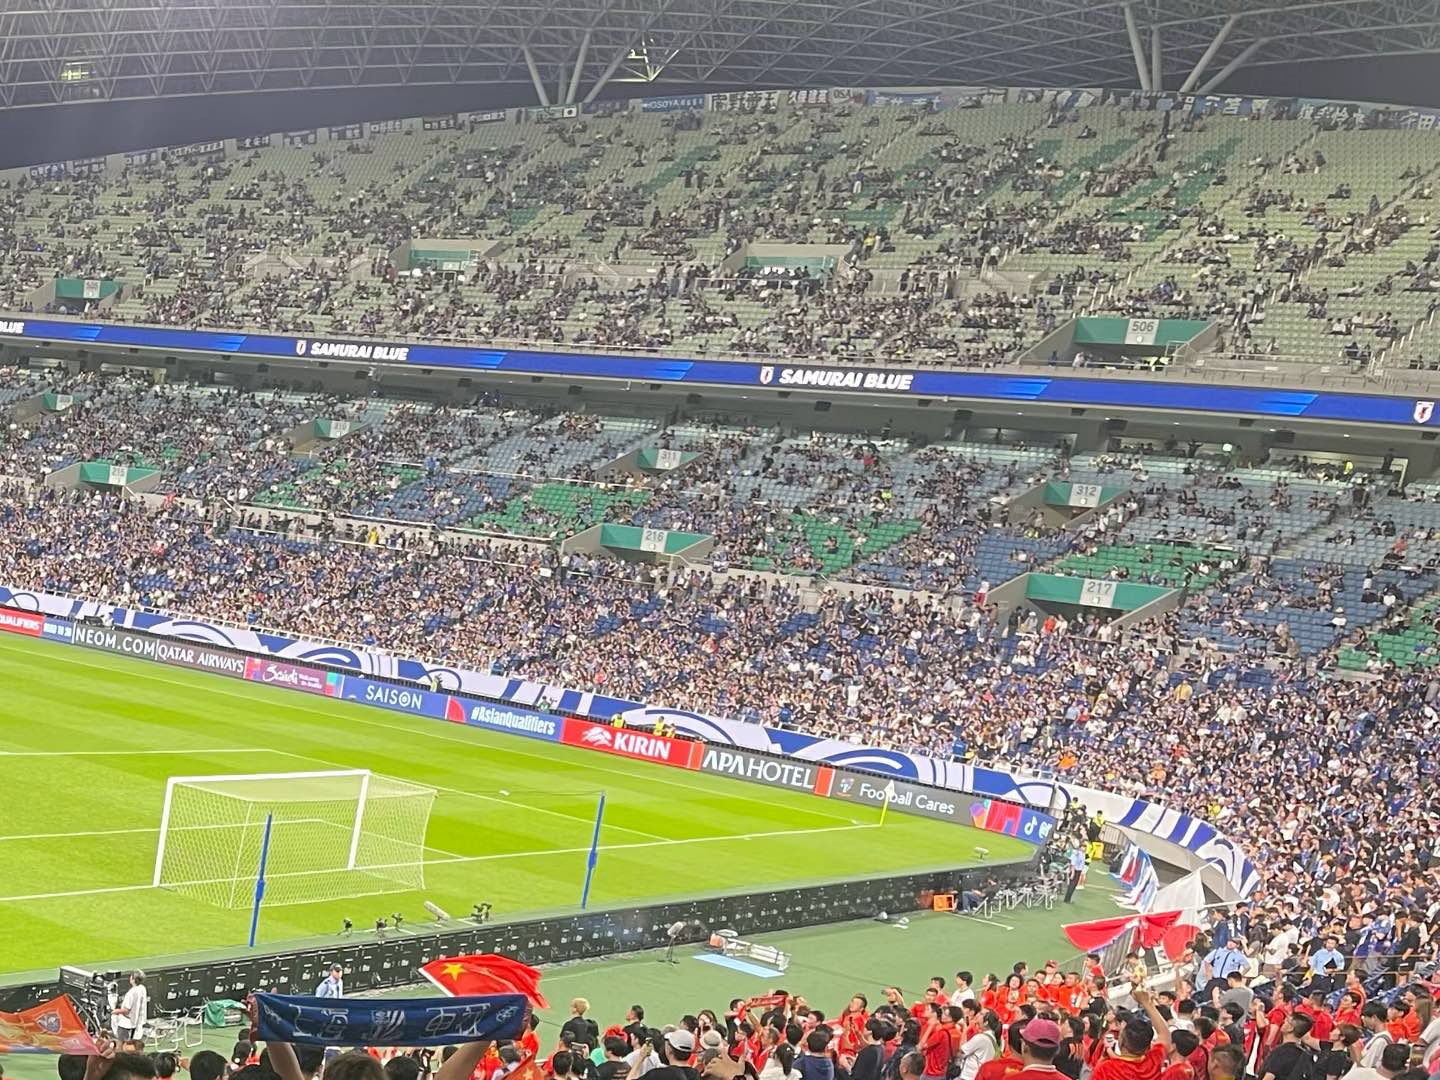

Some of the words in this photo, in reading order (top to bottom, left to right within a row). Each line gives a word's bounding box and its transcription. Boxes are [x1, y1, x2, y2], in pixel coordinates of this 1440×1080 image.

[1133, 321, 1154, 332] 506
[310, 342, 372, 359] SAMURAI
[372, 347, 409, 361] BLUE
[778, 369, 864, 388] SAMURAI
[863, 373, 914, 390] BLUE
[1076, 486, 1096, 496] 312
[647, 531, 663, 541] 216
[1088, 582, 1112, 594] 217
[75, 627, 154, 656] NEOM.COM
[158, 645, 194, 663] QATAR
[198, 654, 244, 673] AIRWAYS
[365, 685, 422, 710] SAISON
[470, 706, 556, 735] #AsianQualifiers
[613, 732, 671, 760] KIRIN
[702, 750, 745, 776] APA
[746, 761, 815, 790] HOTEL
[860, 783, 912, 805] Fooball
[916, 796, 955, 815] Cares
